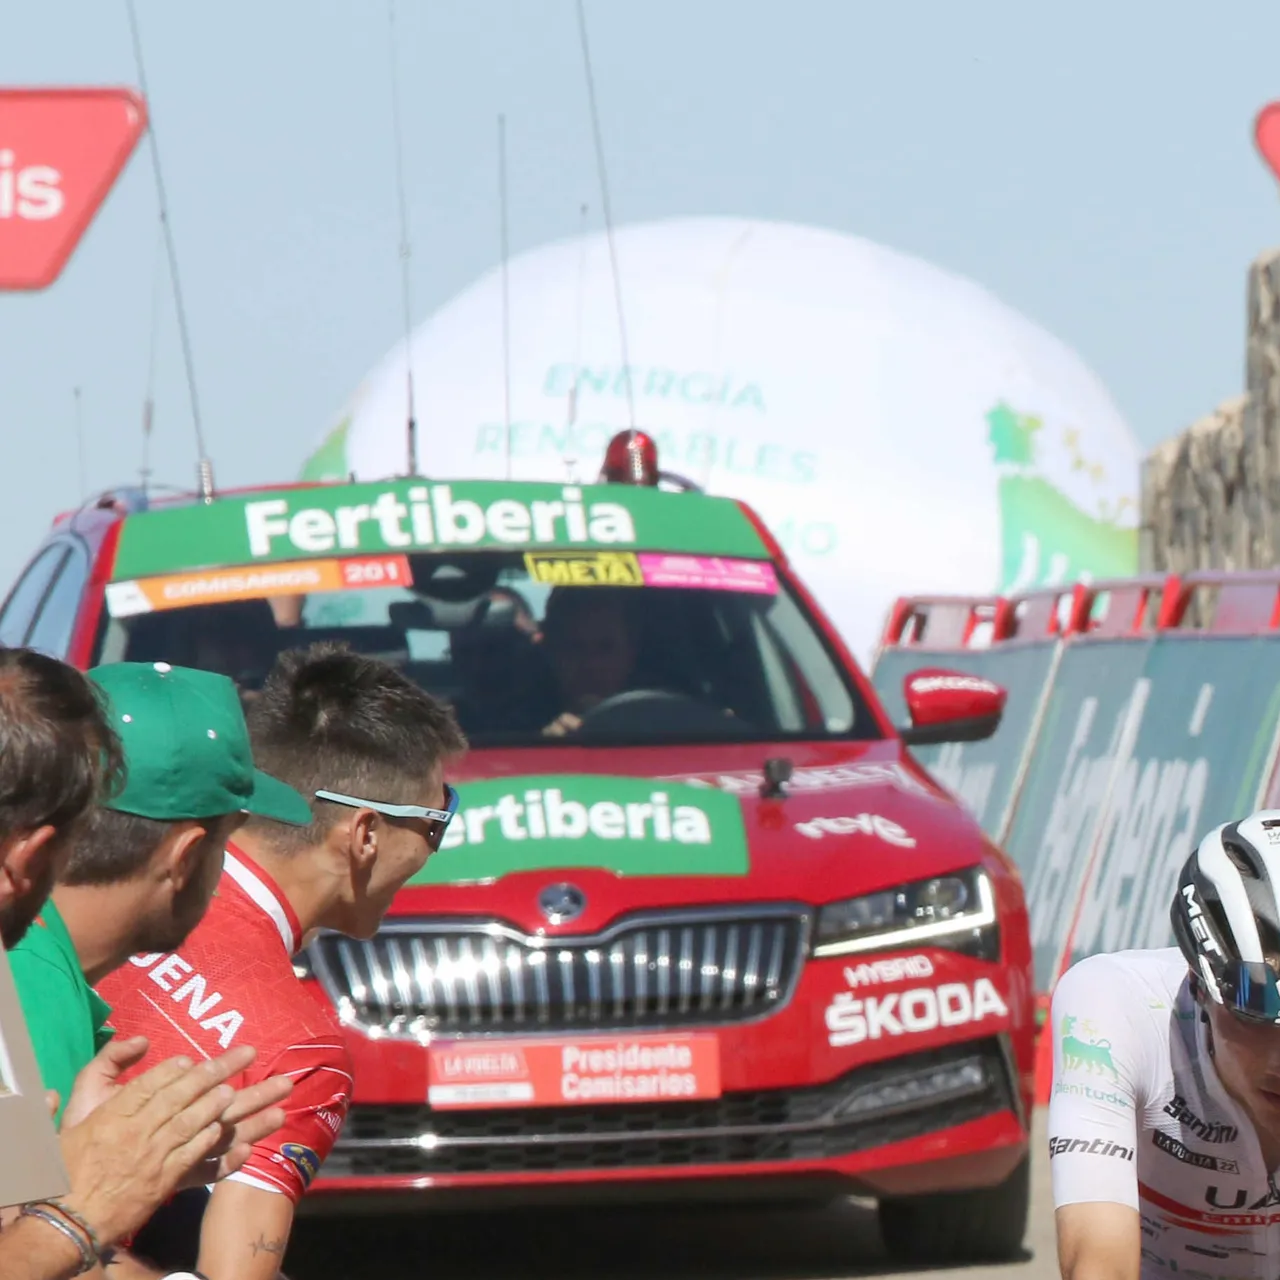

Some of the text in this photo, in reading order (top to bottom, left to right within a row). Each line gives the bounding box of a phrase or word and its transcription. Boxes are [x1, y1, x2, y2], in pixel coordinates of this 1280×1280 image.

[474, 418, 822, 486] RENOABLES
[244, 485, 636, 552] Fertiberia
[163, 561, 399, 600] COMISARIOS 201
[535, 560, 637, 583] META
[843, 954, 934, 987] HYBRID
[825, 978, 1008, 1046] ŠKODA
[561, 1041, 694, 1072] Presidente
[561, 1070, 698, 1099] Comisarios
[1163, 1096, 1239, 1144] Santini
[1048, 1135, 1136, 1163] Santini
[1219, 1160, 1236, 1173] 22
